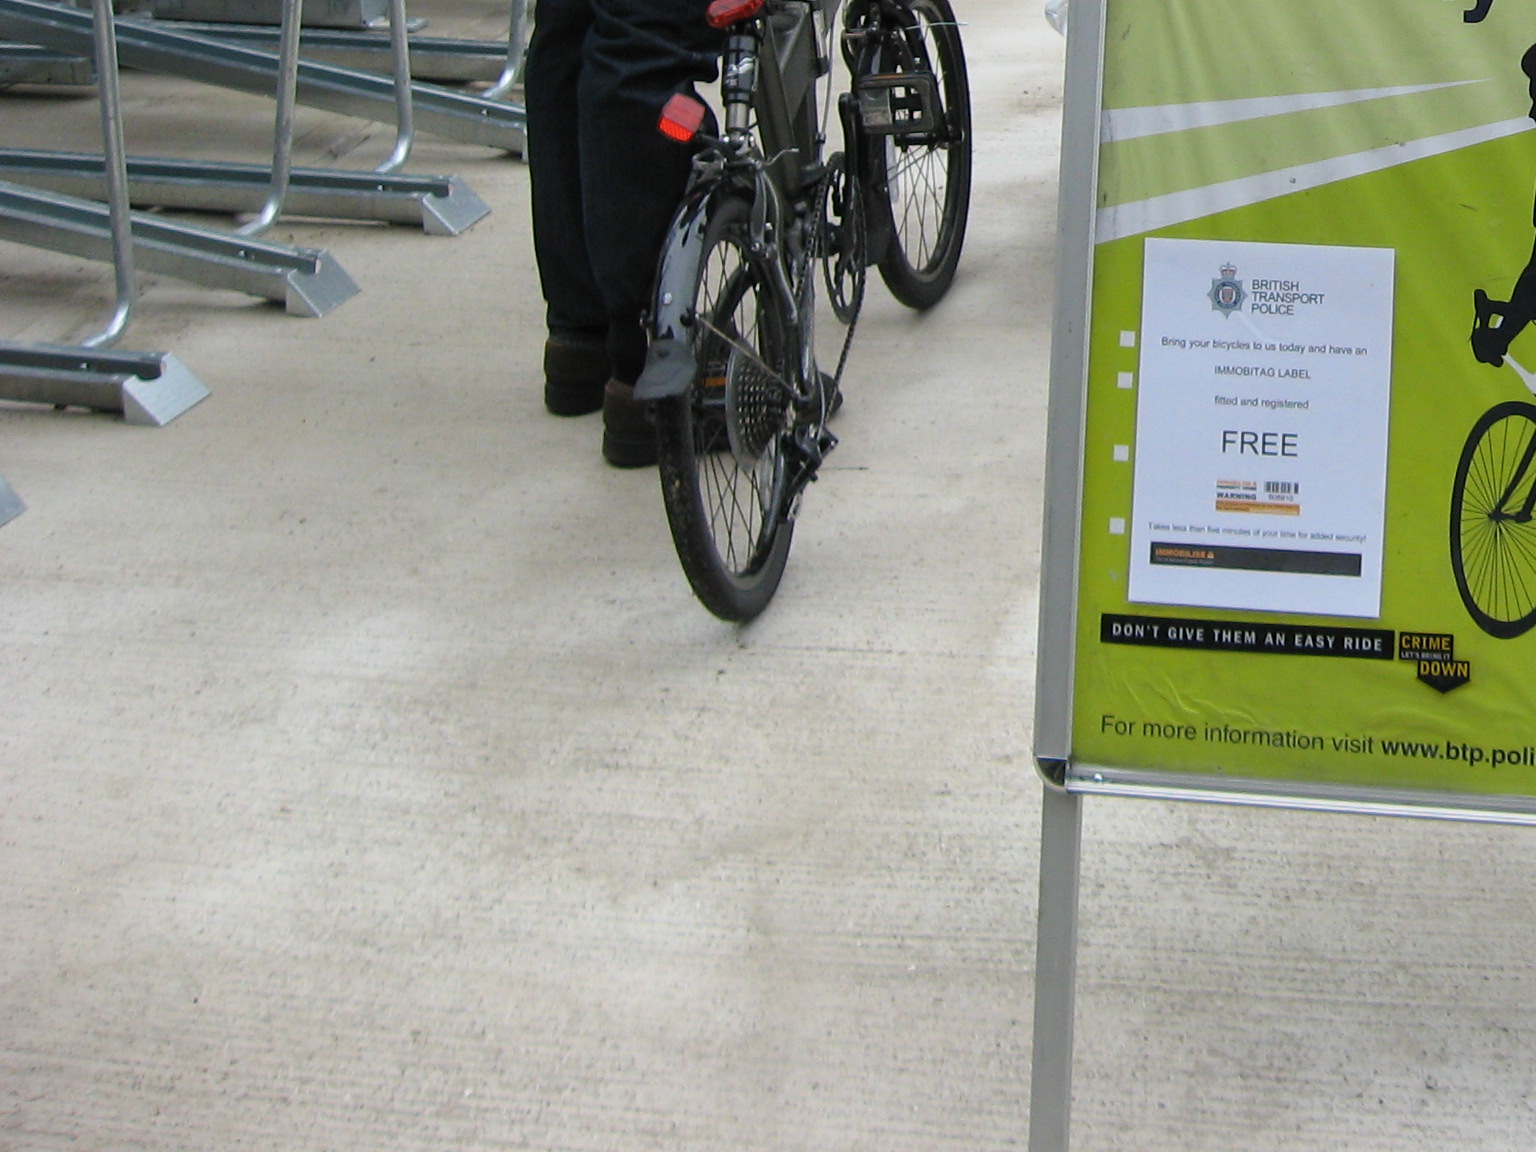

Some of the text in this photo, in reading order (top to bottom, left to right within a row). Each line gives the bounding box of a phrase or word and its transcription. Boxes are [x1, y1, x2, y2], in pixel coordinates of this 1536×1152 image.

[1252, 279, 1299, 291] BRITISH
[1252, 292, 1325, 304] TRANSPORT
[1251, 303, 1294, 315] POLICE
[1161, 336, 1186, 348] Bring
[1189, 340, 1209, 349] your
[1213, 339, 1250, 350] bicycles
[1253, 341, 1262, 350] to
[1279, 343, 1306, 354] today
[1308, 345, 1326, 353] and
[1329, 345, 1352, 354] have
[1214, 366, 1311, 379] IMMOBITAG LABEL
[1214, 396, 1309, 410] fitted and registered
[1222, 430, 1298, 457] FREE
[1217, 492, 1256, 500] WARNING
[1112, 623, 1383, 651] DON'T GIVE THEM AN EASY RIDE
[1401, 635, 1450, 650] CRIME
[1420, 661, 1468, 677] DOWN
[1101, 715, 1135, 736] For
[1143, 722, 1197, 740] more
[1205, 723, 1324, 750] information
[1332, 734, 1374, 754] visit
